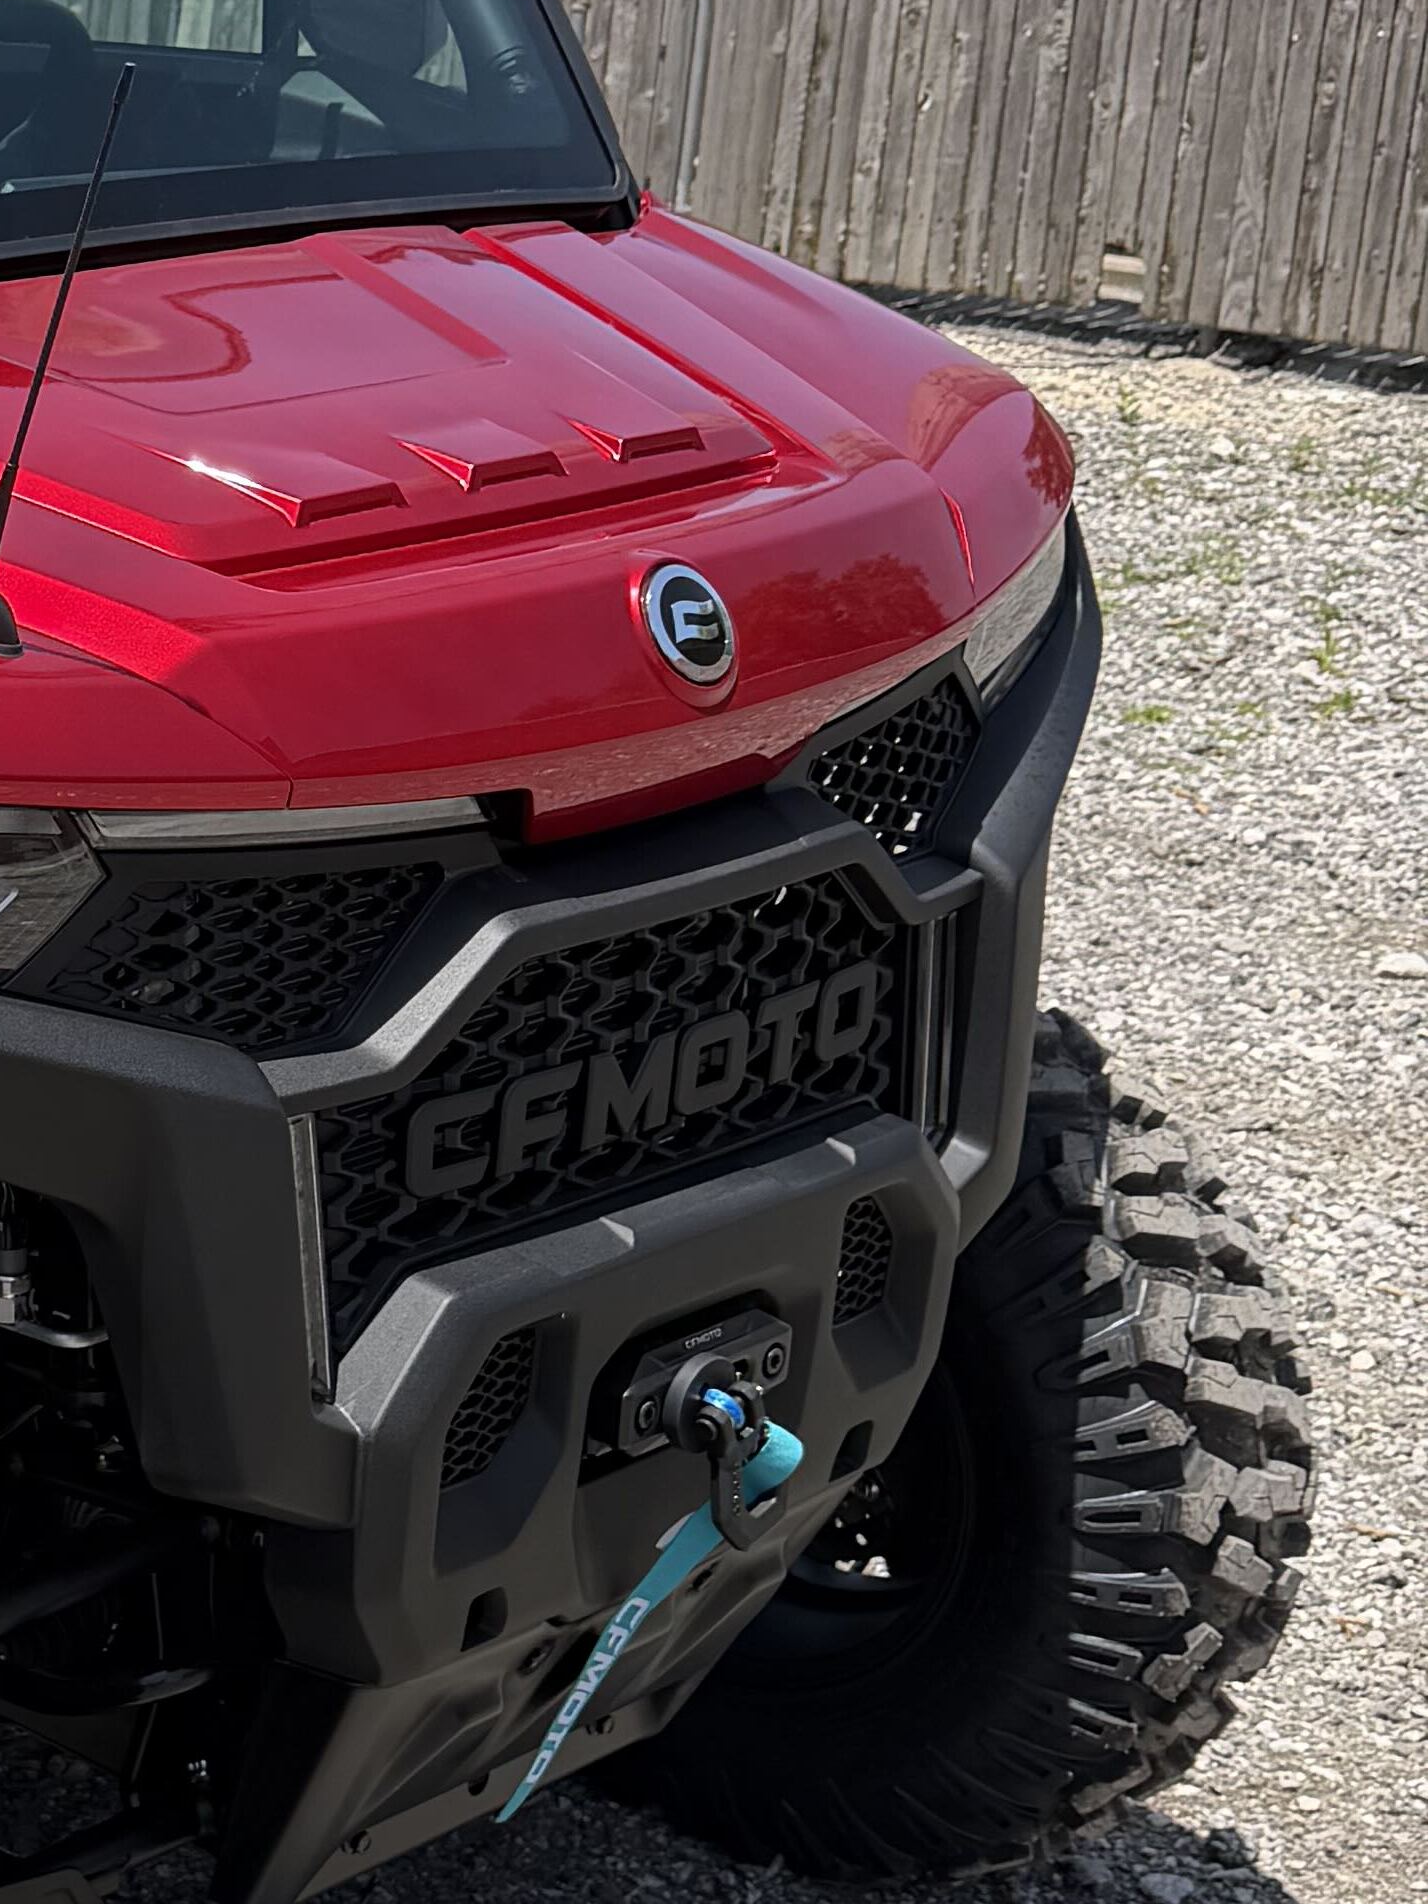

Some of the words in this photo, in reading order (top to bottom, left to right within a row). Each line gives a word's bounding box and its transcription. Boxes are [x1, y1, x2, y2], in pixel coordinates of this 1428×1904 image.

[404, 960, 883, 1198] CFMOTO
[684, 1327, 723, 1350] CFMOTO
[523, 1596, 651, 1786] CFMOTO
